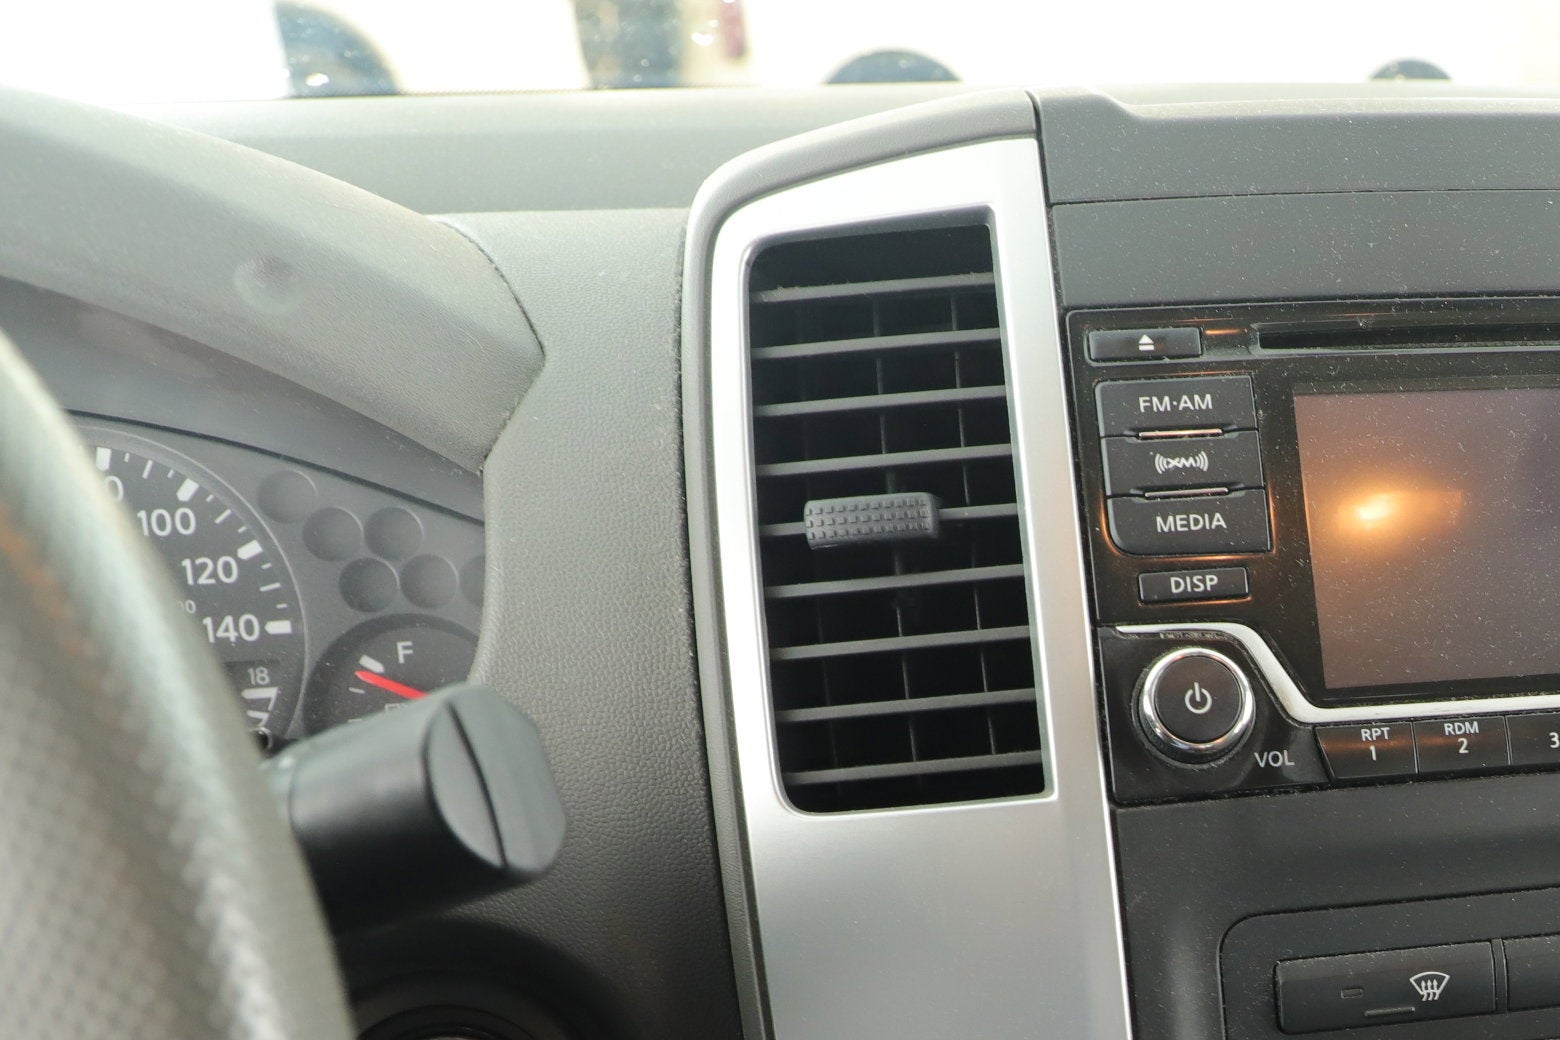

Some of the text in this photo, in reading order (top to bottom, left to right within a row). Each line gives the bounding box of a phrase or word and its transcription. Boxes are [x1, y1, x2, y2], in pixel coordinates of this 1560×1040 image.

[137, 507, 196, 537] 100
[1155, 512, 1227, 533] MEDIA
[181, 555, 239, 587] 120
[1169, 574, 1219, 594] DISP
[202, 613, 260, 644] 140
[396, 640, 414, 665] F
[247, 666, 270, 685] 18
[1360, 726, 1390, 742] RPT
[1443, 720, 1479, 737] RDM
[1457, 738, 1469, 754] 2
[1548, 731, 1560, 749] 3
[1254, 750, 1295, 769] VOL
[1369, 745, 1377, 761] 1
